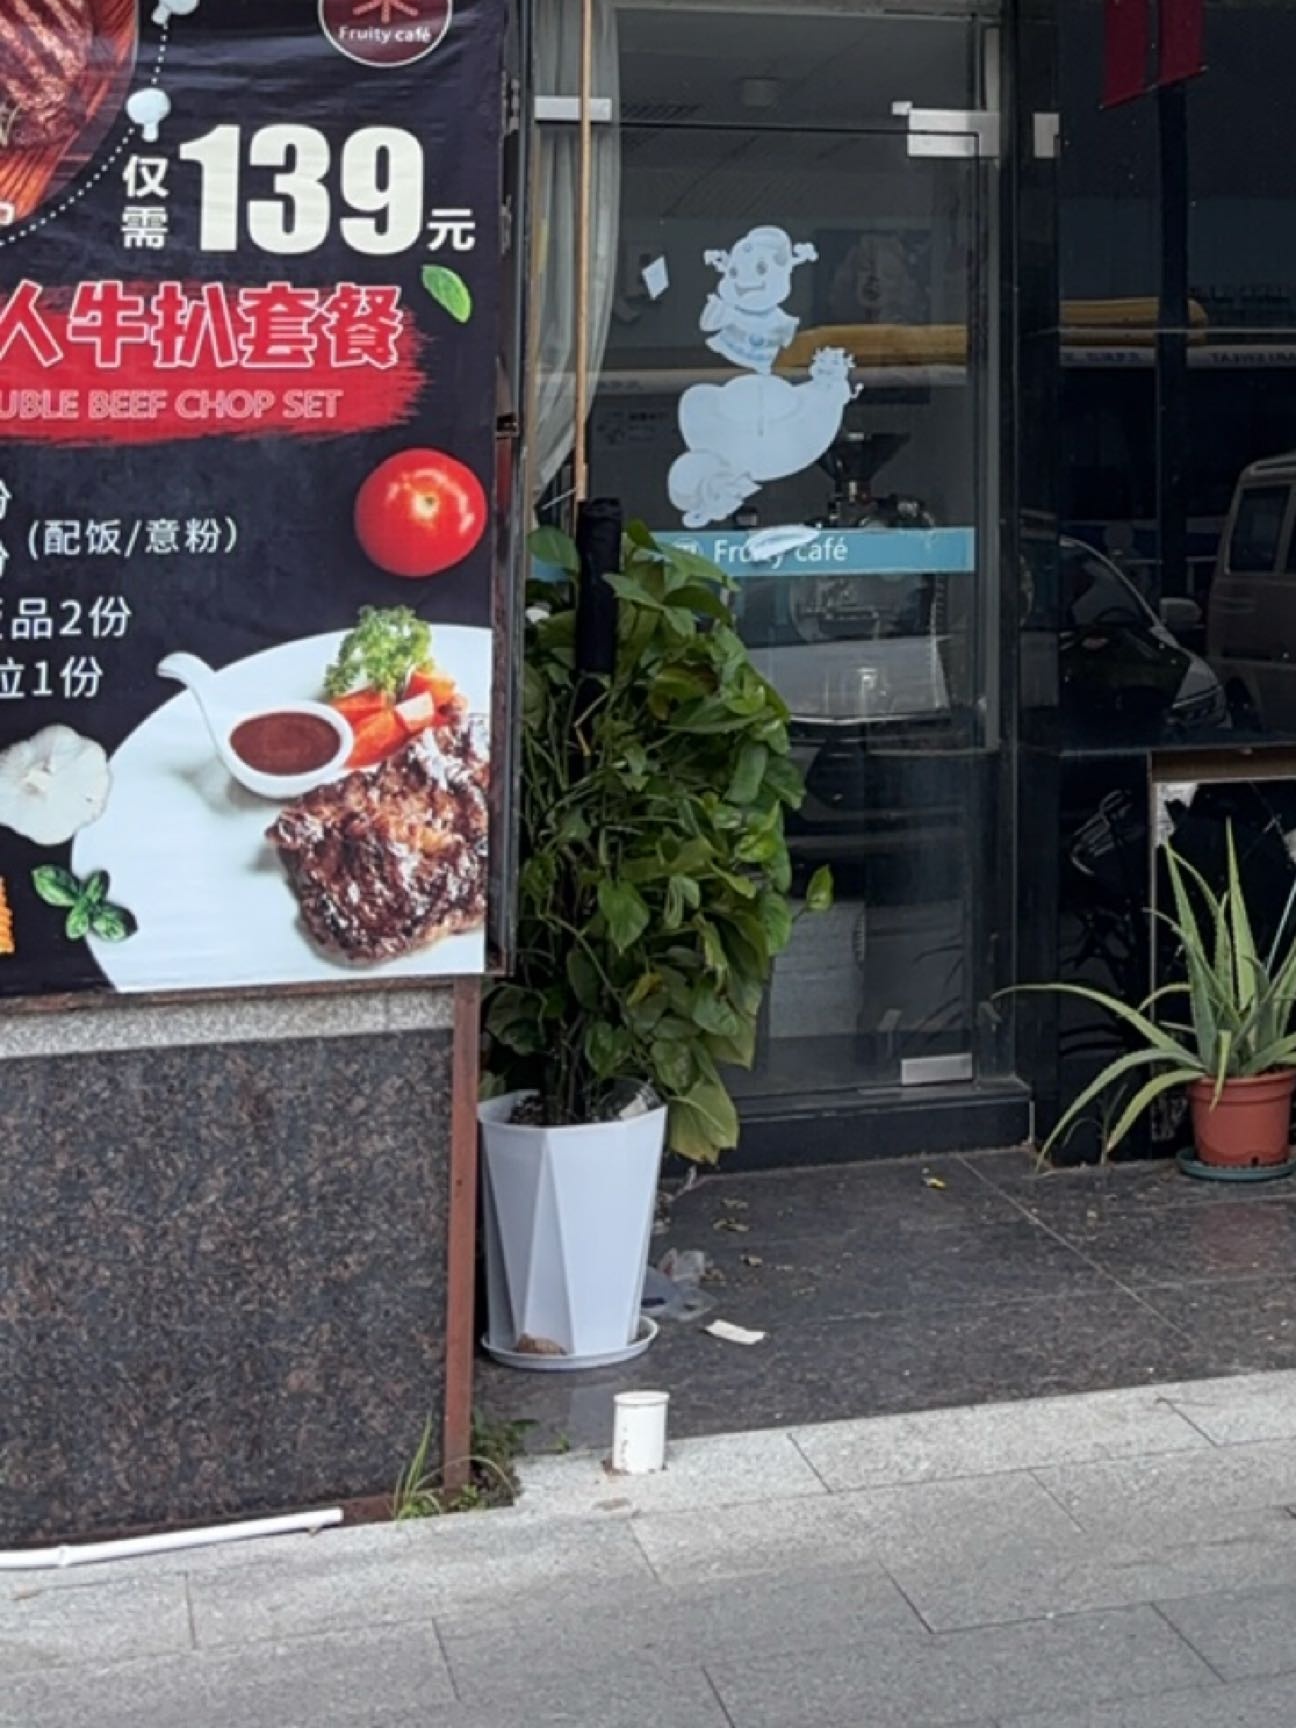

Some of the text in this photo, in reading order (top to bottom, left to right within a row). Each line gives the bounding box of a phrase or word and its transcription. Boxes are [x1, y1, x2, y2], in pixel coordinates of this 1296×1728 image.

[338, 25, 391, 44] Fruity
[88, 389, 168, 419] BEEF
[174, 389, 276, 419] CHOP
[282, 389, 344, 419] SET
[795, 536, 848, 562] café
[0, 596, 132, 640] 品2份
